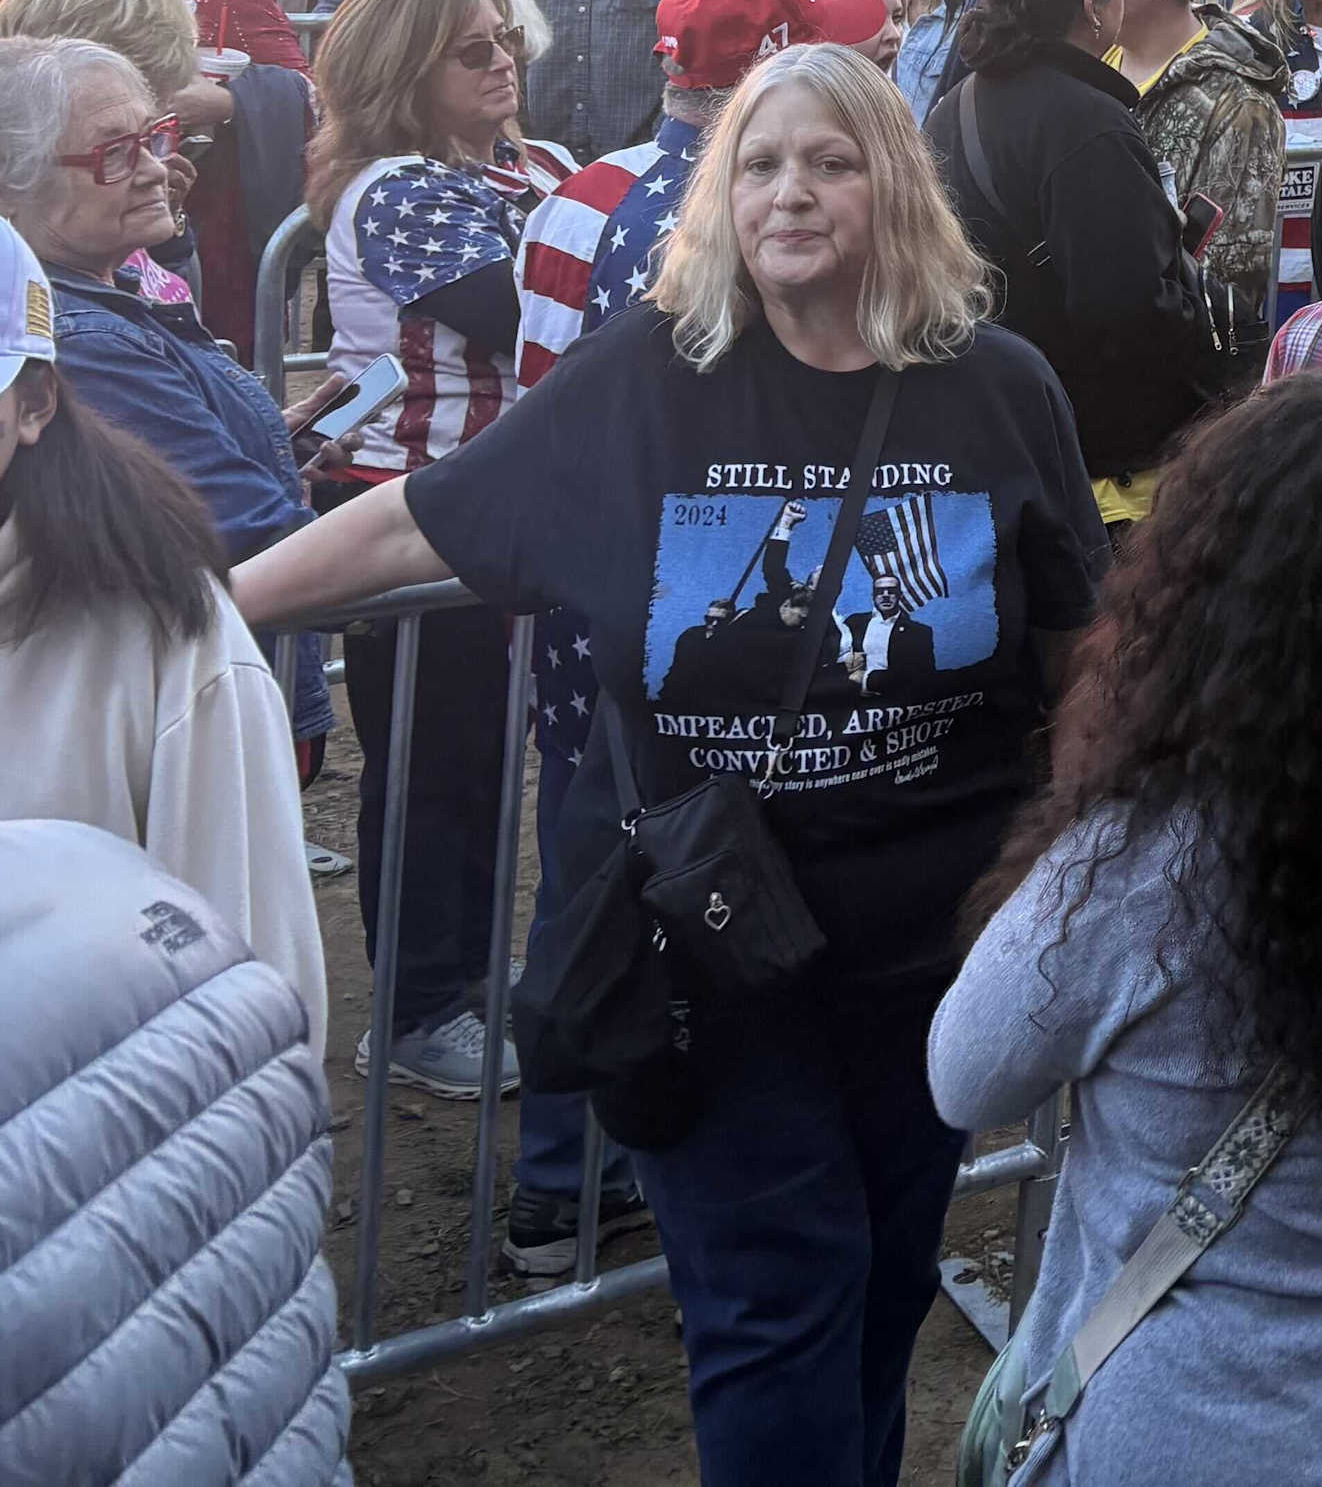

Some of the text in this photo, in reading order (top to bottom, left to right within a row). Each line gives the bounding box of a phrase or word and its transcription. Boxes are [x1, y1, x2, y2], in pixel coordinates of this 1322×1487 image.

[1280, 184, 1313, 198] TALS
[706, 464, 793, 489] STILL
[674, 504, 728, 527] 2024
[654, 691, 984, 741] IMPEACED, ARRESTED,
[860, 739, 877, 762] &
[885, 717, 954, 756] SHOT!
[784, 778, 804, 792] story
[814, 773, 850, 790] anywhere
